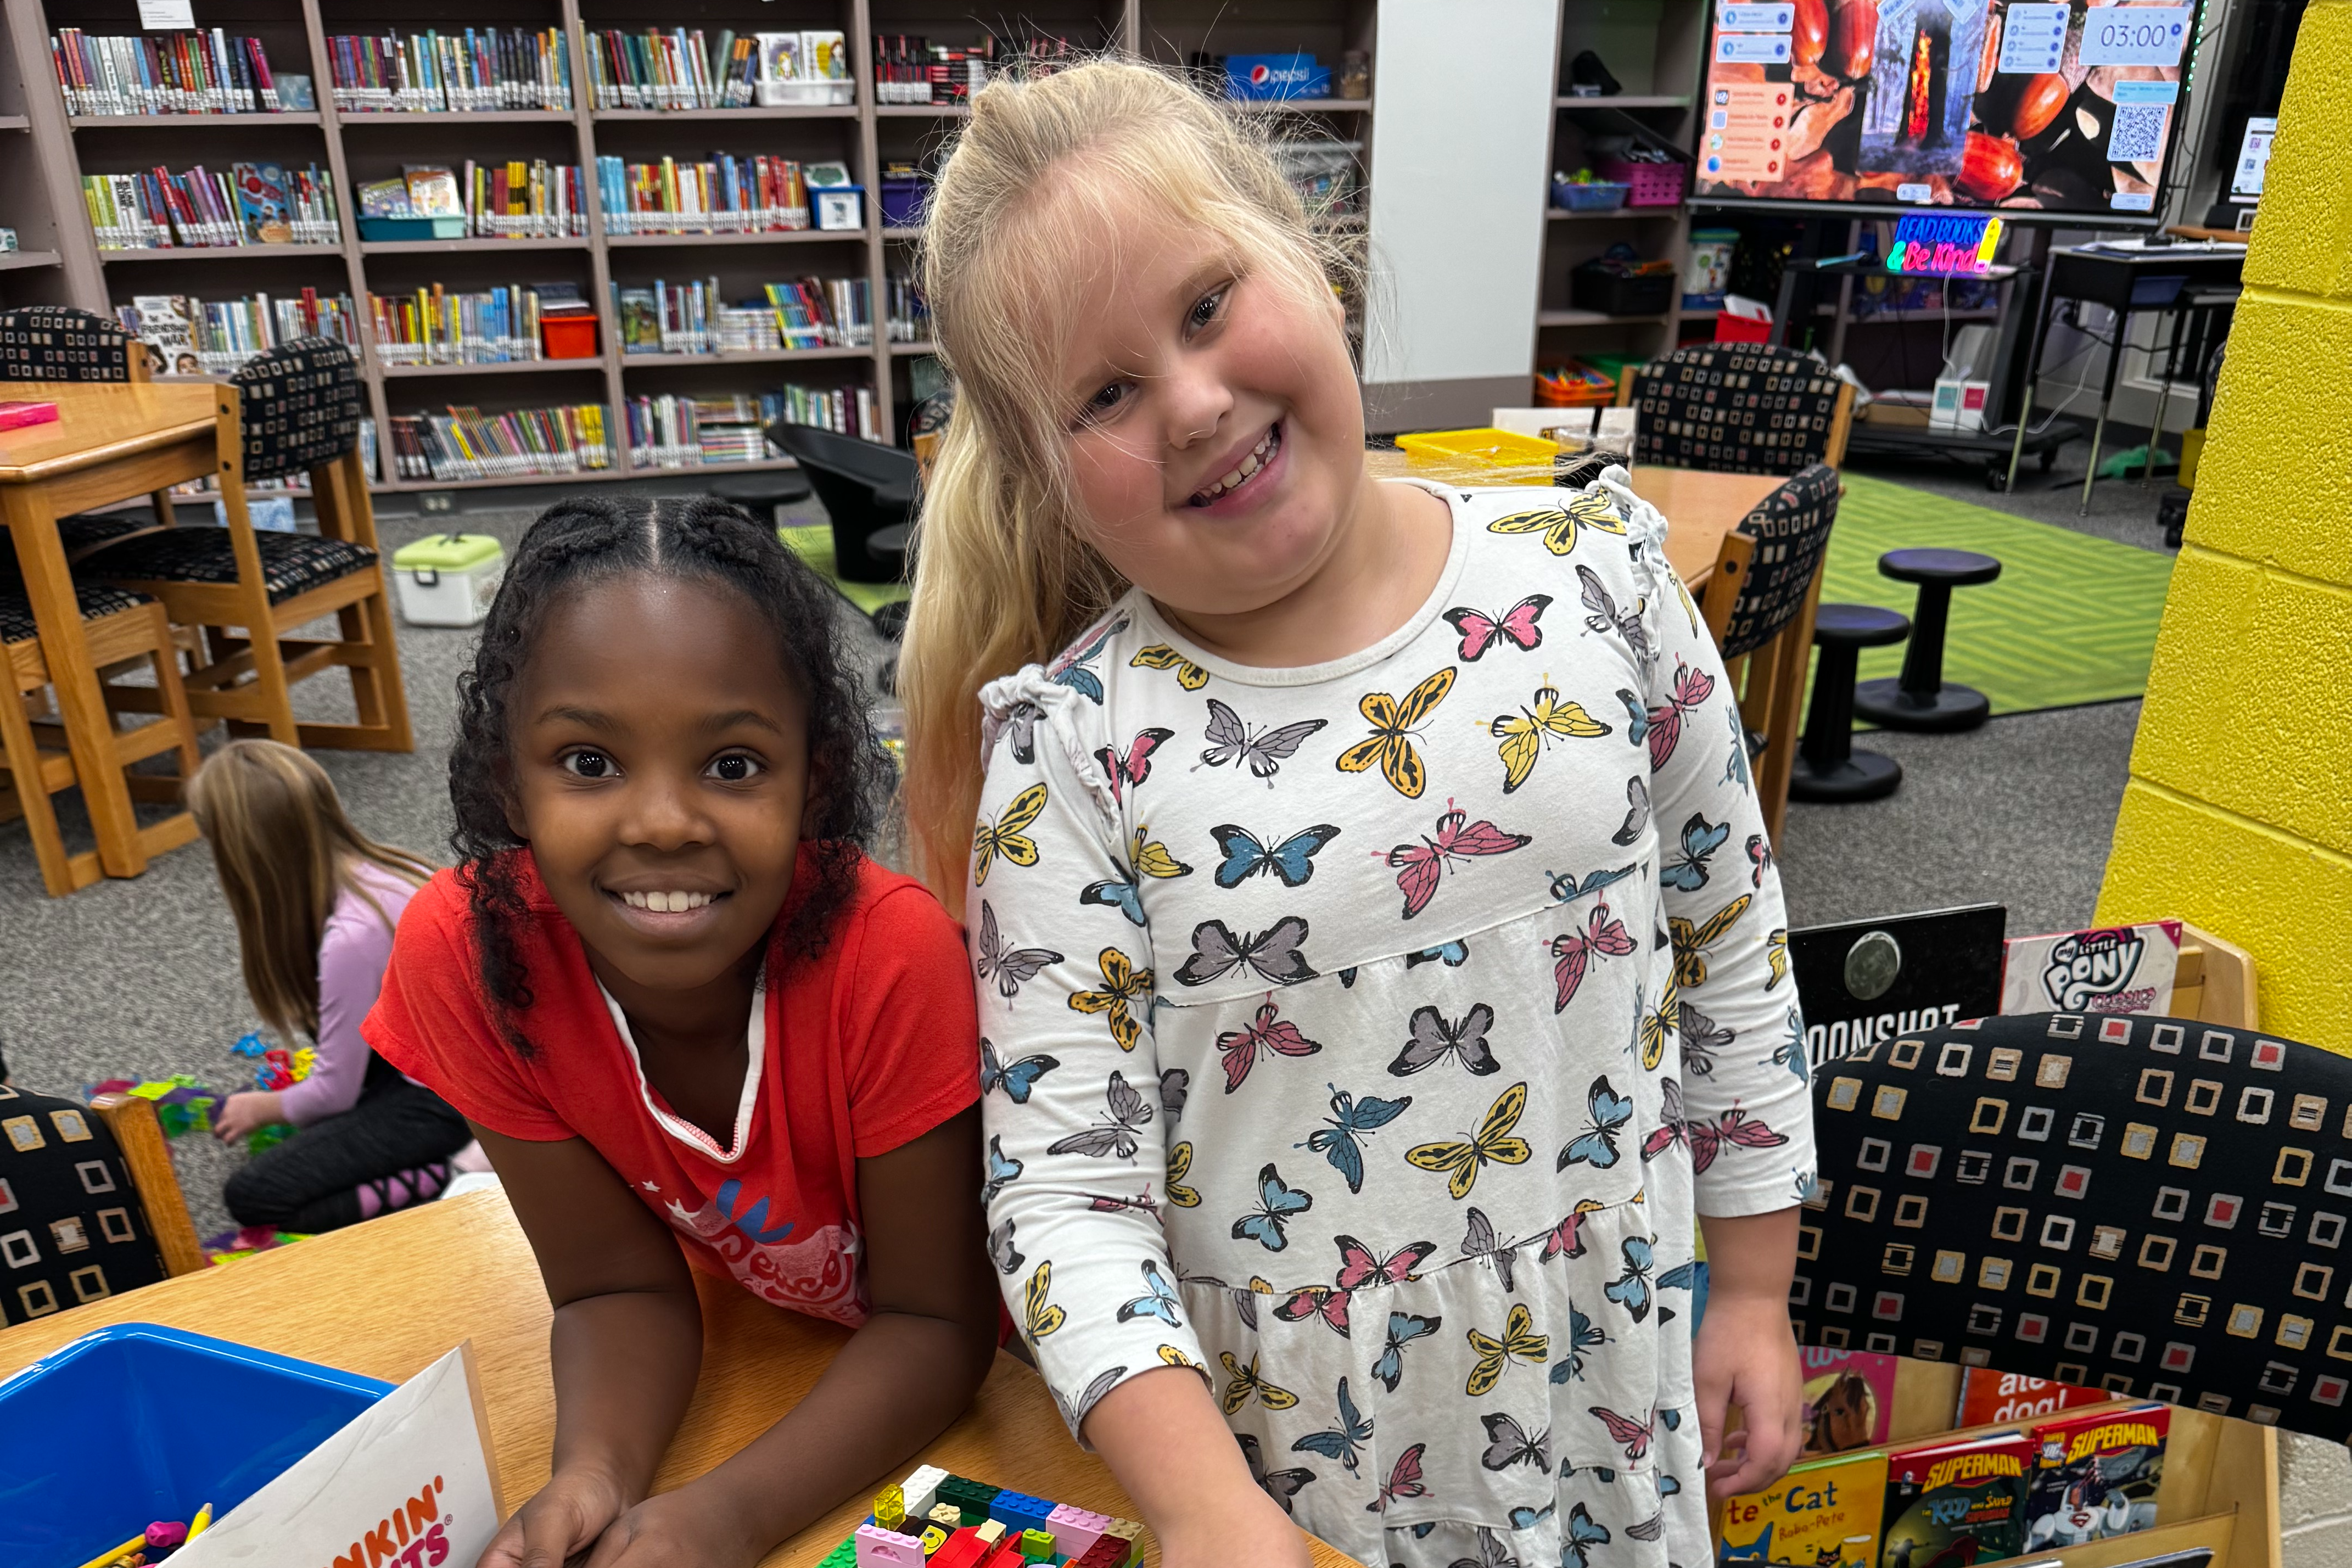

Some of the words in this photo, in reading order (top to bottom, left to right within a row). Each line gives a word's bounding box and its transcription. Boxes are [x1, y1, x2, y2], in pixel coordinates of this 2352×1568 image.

[2101, 24, 2166, 48] 03:00
[1270, 66, 1309, 85] pepsi
[1895, 216, 1935, 243] READ
[1936, 217, 1986, 243] BOOKS
[1903, 241, 1930, 271] Be
[1931, 242, 1979, 271] Kind
[2079, 938, 2118, 955] LITTLE
[2046, 940, 2140, 1010] PONY
[1807, 1003, 1961, 1069] OONSHOT
[2065, 1423, 2159, 1465] SUPERMAN
[1921, 1454, 2023, 1494] SUPERMAN
[1727, 1499, 1759, 1525] te
[1762, 1493, 1782, 1507] the
[1784, 1481, 1838, 1514] Cat
[1928, 1497, 1971, 1526] KID
[322, 1475, 444, 1568] NKIN'
[1778, 1511, 1845, 1542] Robo-Pete
